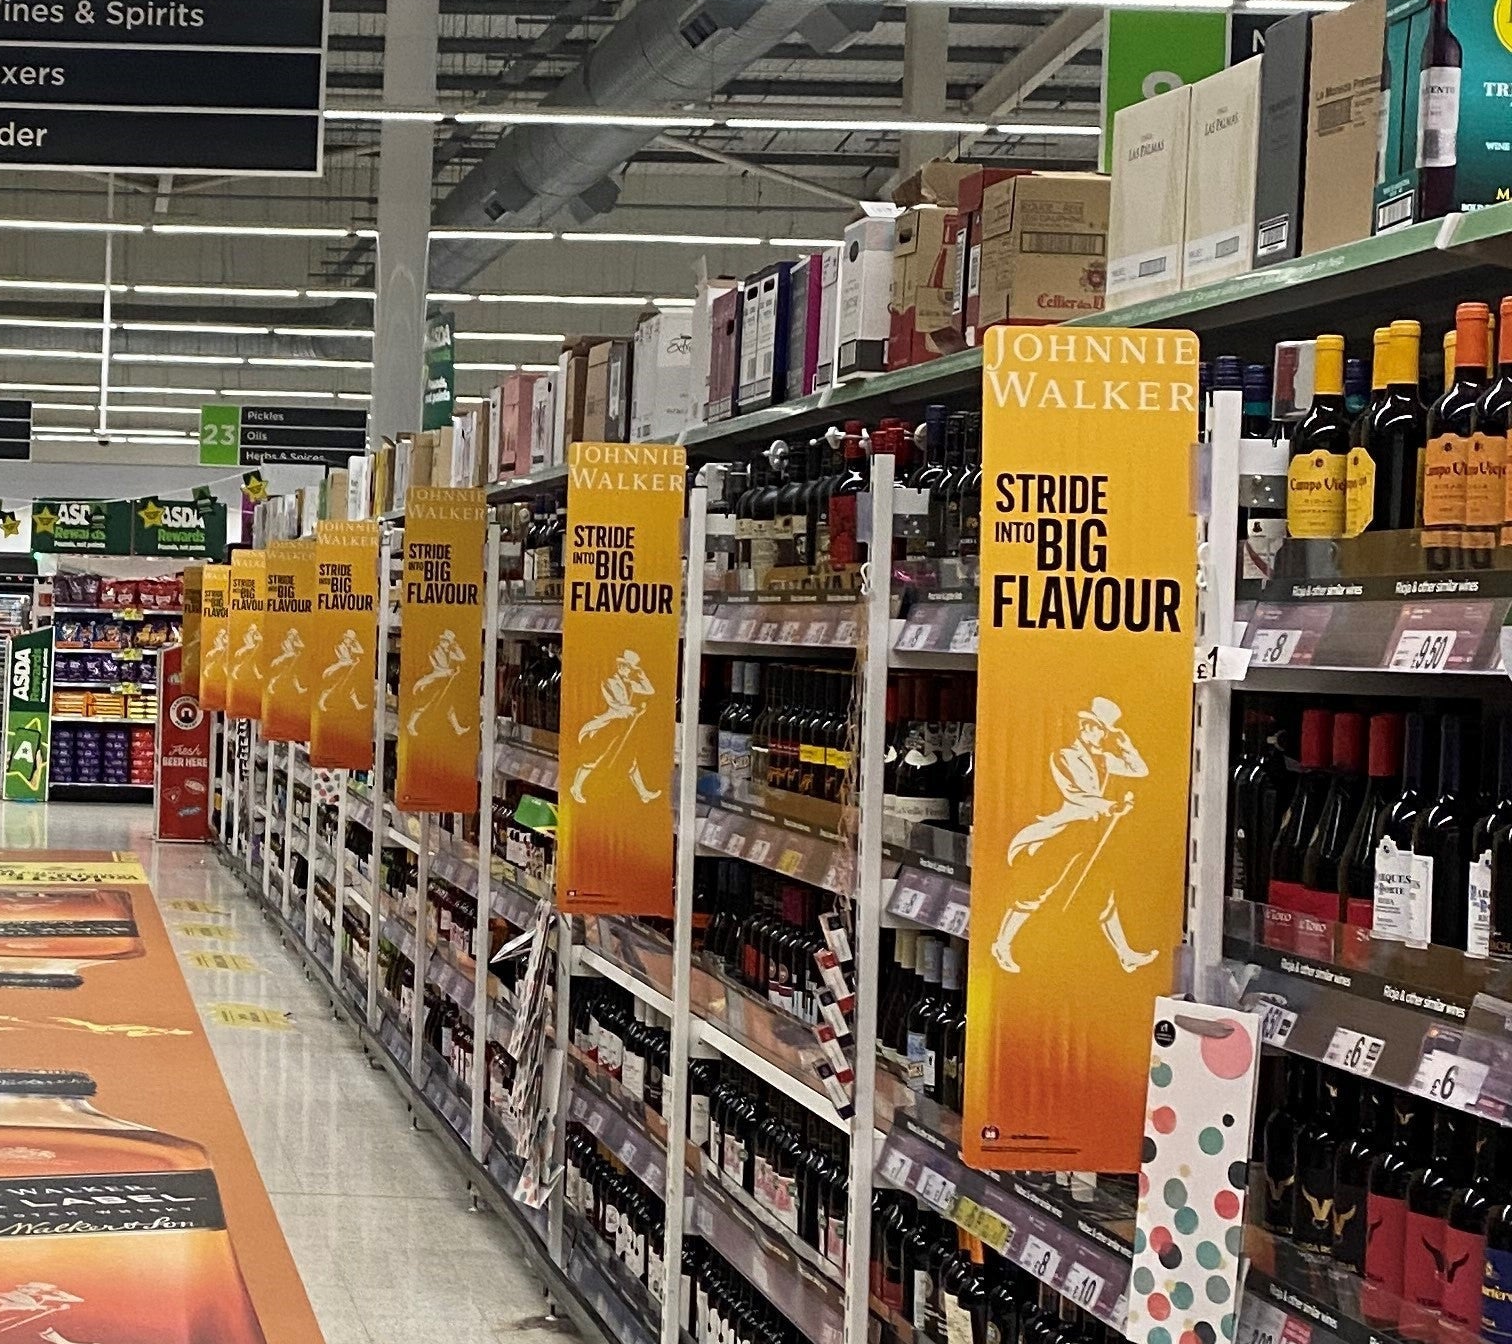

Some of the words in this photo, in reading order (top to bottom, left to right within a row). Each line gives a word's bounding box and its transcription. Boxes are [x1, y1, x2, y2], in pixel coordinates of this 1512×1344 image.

[75, 1, 95, 24] &
[106, 0, 204, 29] Spirits
[986, 327, 1195, 370] JOHNNIE
[987, 371, 1195, 412] WALKER
[247, 411, 284, 421] Pickles
[203, 424, 235, 445] 23
[247, 431, 268, 441] Oils
[571, 443, 685, 466] JOHNNIE
[571, 466, 683, 491] WALKER
[996, 473, 1108, 515] STRIDE
[56, 504, 91, 525] ASD
[574, 525, 635, 548] STRIDE
[995, 522, 1034, 543] INTO
[1038, 518, 1108, 573] BIG
[409, 543, 452, 560] STRIDE
[424, 561, 451, 582] BIG
[573, 552, 594, 564] INTO
[595, 550, 634, 581] BIG
[407, 583, 478, 605] FLAVOUR
[571, 582, 673, 614] FLAVOUR
[993, 575, 1180, 632] FLAVOUR
[13, 647, 31, 701] ASDA
[1197, 646, 1219, 679] £1
[162, 756, 184, 767] BEER
[186, 756, 208, 767] HERE
[20, 1193, 198, 1208] LABEL
